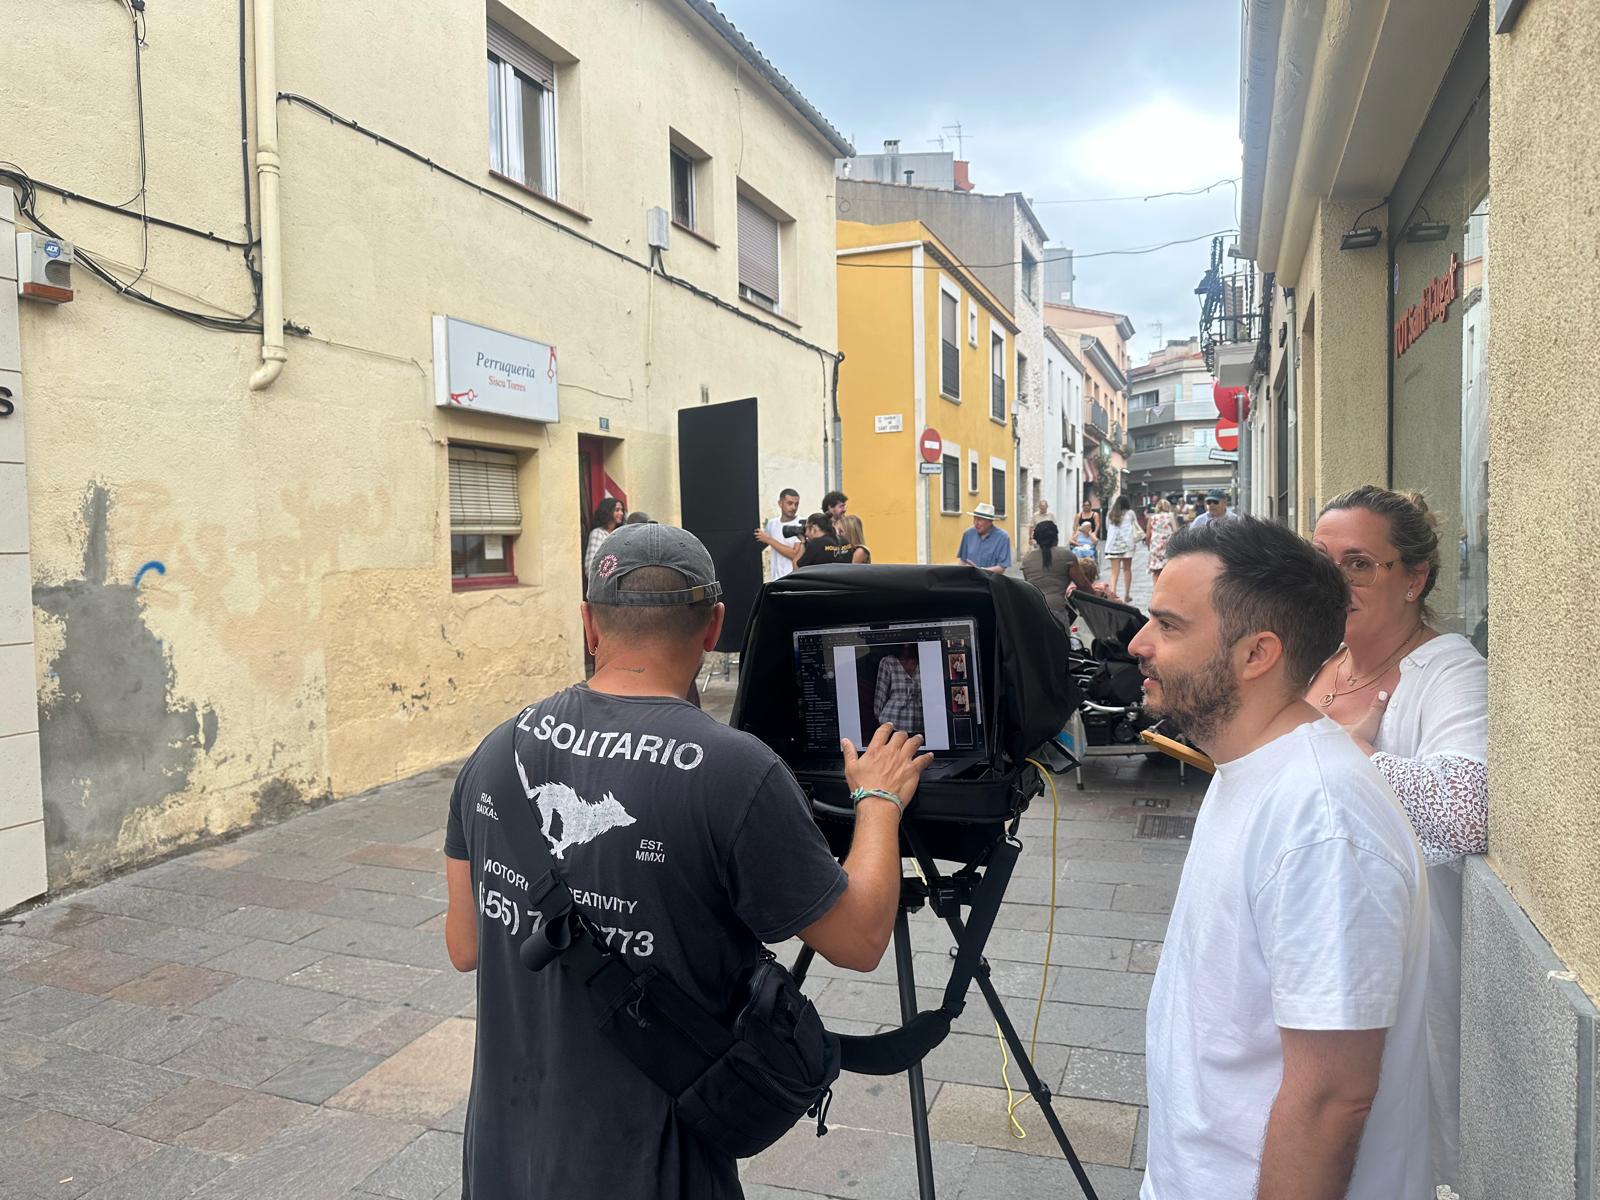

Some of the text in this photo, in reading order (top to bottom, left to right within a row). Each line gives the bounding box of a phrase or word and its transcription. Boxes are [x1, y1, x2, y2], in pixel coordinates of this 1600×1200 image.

[476, 351, 535, 378] Perruqueria
[516, 707, 704, 771] L SOLITARIO
[480, 792, 494, 806] RIA
[635, 850, 665, 863] MMXI
[639, 839, 664, 851] EST.
[479, 881, 520, 935] (55)
[568, 886, 638, 914] EATIVITY
